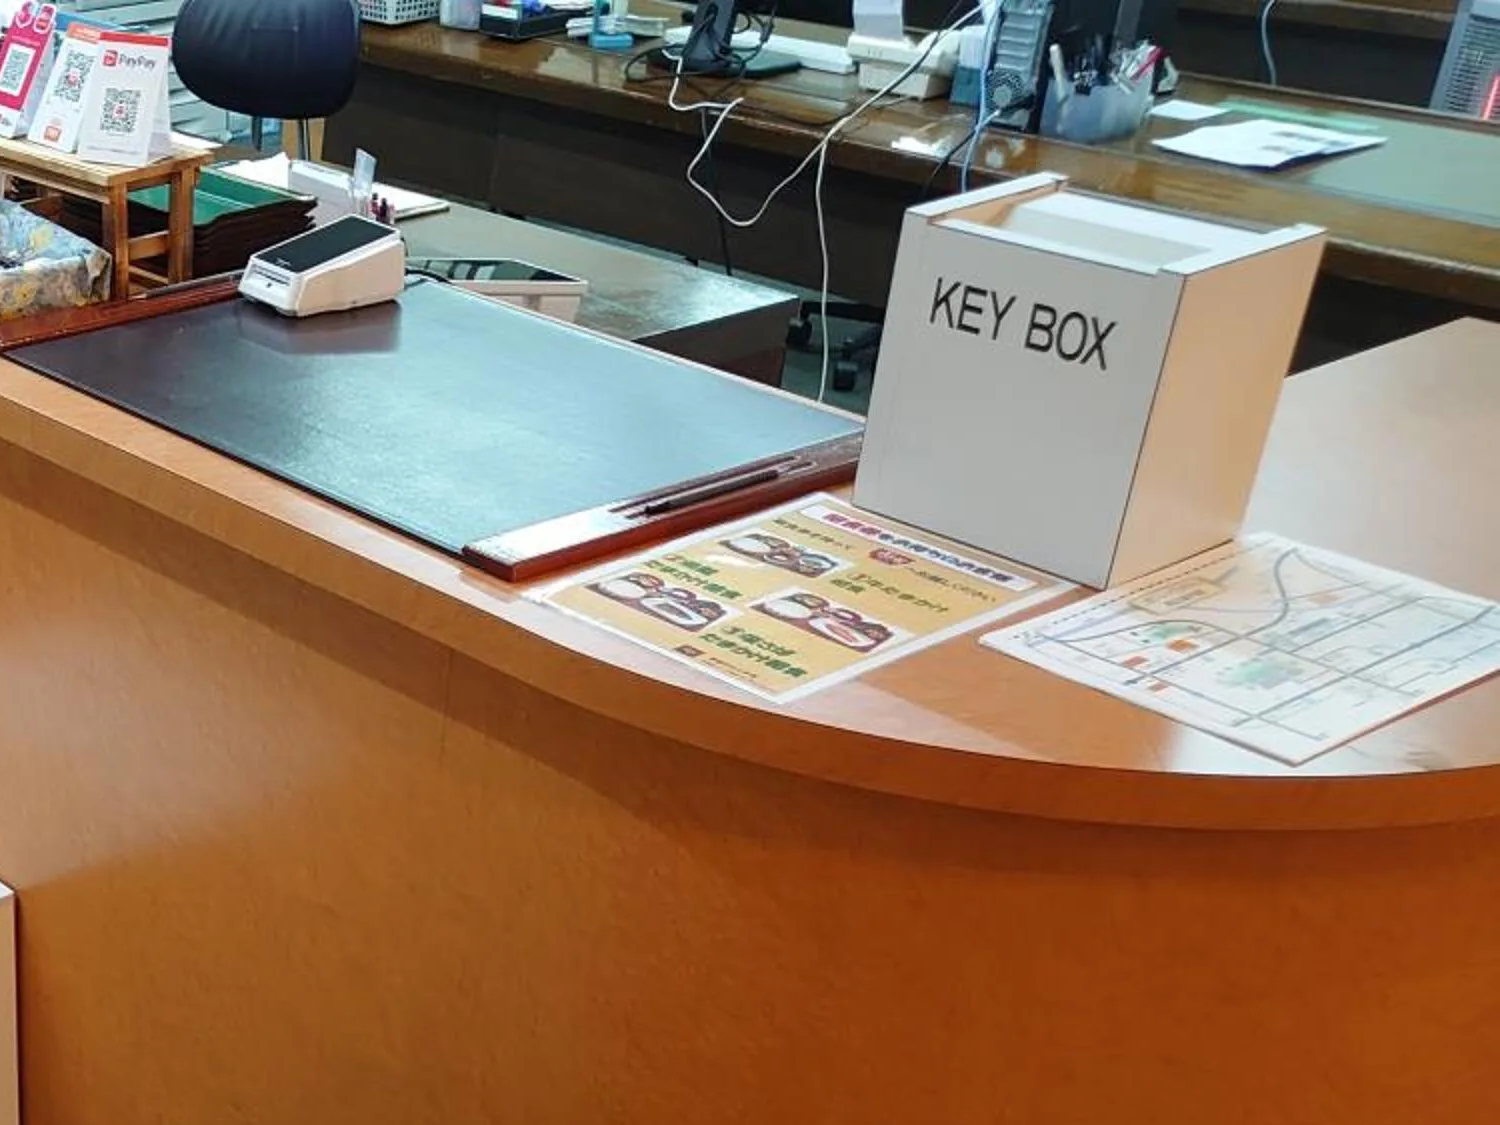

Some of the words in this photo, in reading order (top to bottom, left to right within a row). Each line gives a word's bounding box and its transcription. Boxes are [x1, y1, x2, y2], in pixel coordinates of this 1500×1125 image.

[119, 52, 156, 70] PayPay
[929, 276, 1017, 341] KEY
[1024, 302, 1118, 371] BOX
